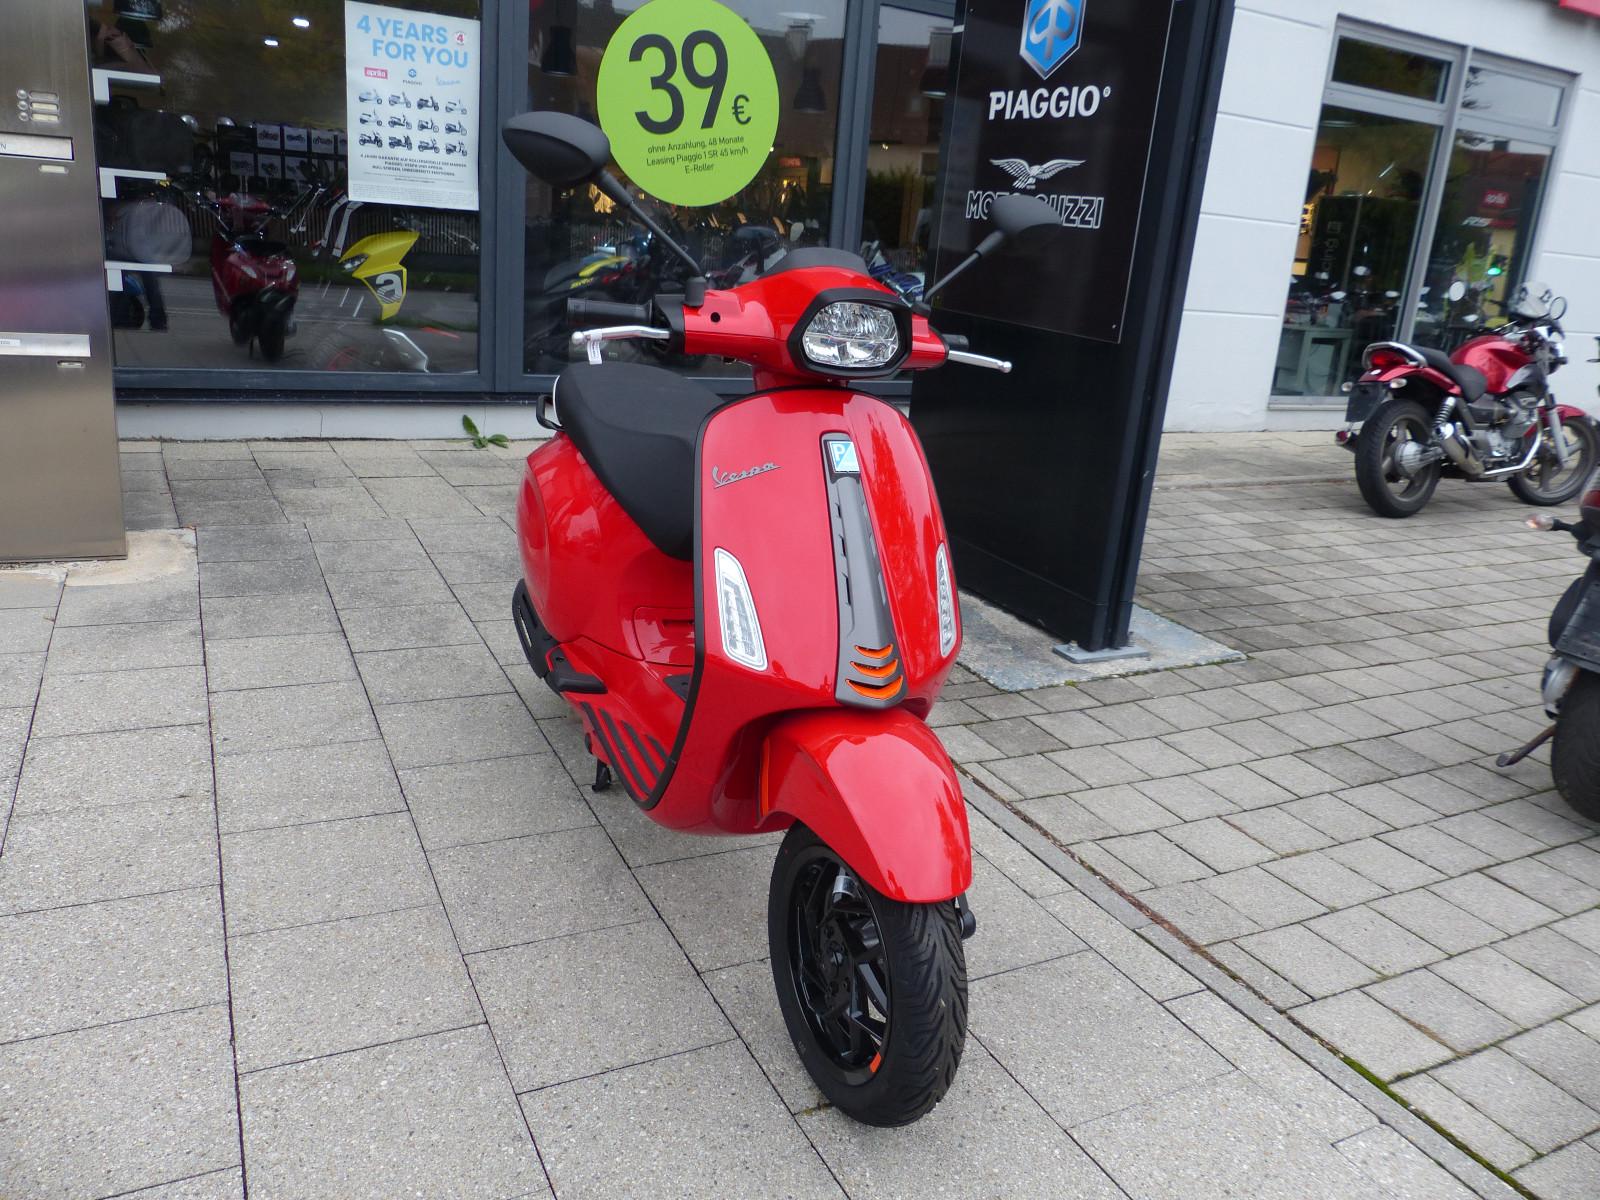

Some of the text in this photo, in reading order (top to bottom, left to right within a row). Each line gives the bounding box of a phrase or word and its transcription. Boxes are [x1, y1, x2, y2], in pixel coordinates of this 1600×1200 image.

[357, 15, 448, 44] 4 YEARS
[372, 39, 468, 68] FOR YOU
[629, 29, 729, 135] 39
[646, 157, 675, 166] Leasing
[676, 152, 703, 162] Piaggio
[719, 149, 729, 157] 45
[729, 146, 749, 156] km/h
[647, 146, 666, 154] ohne
[718, 136, 745, 145] Monate
[685, 163, 715, 174] E-Roller
[712, 462, 781, 489] Vespa
